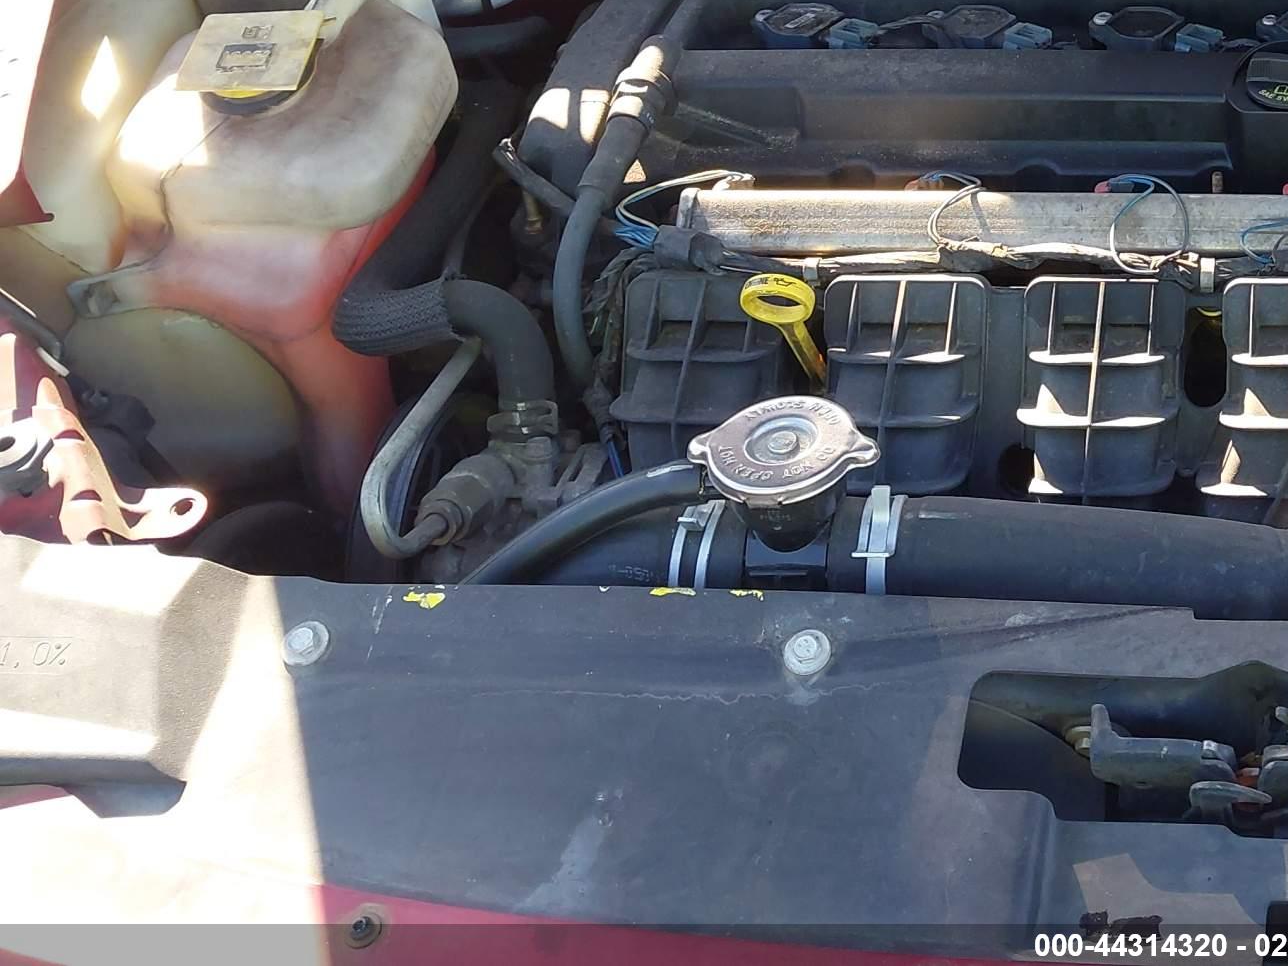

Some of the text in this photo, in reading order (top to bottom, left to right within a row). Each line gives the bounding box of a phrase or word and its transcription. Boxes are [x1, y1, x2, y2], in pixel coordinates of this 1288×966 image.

[1258, 89, 1276, 100] SAE
[717, 444, 738, 467] HOT
[781, 461, 817, 480] NOT
